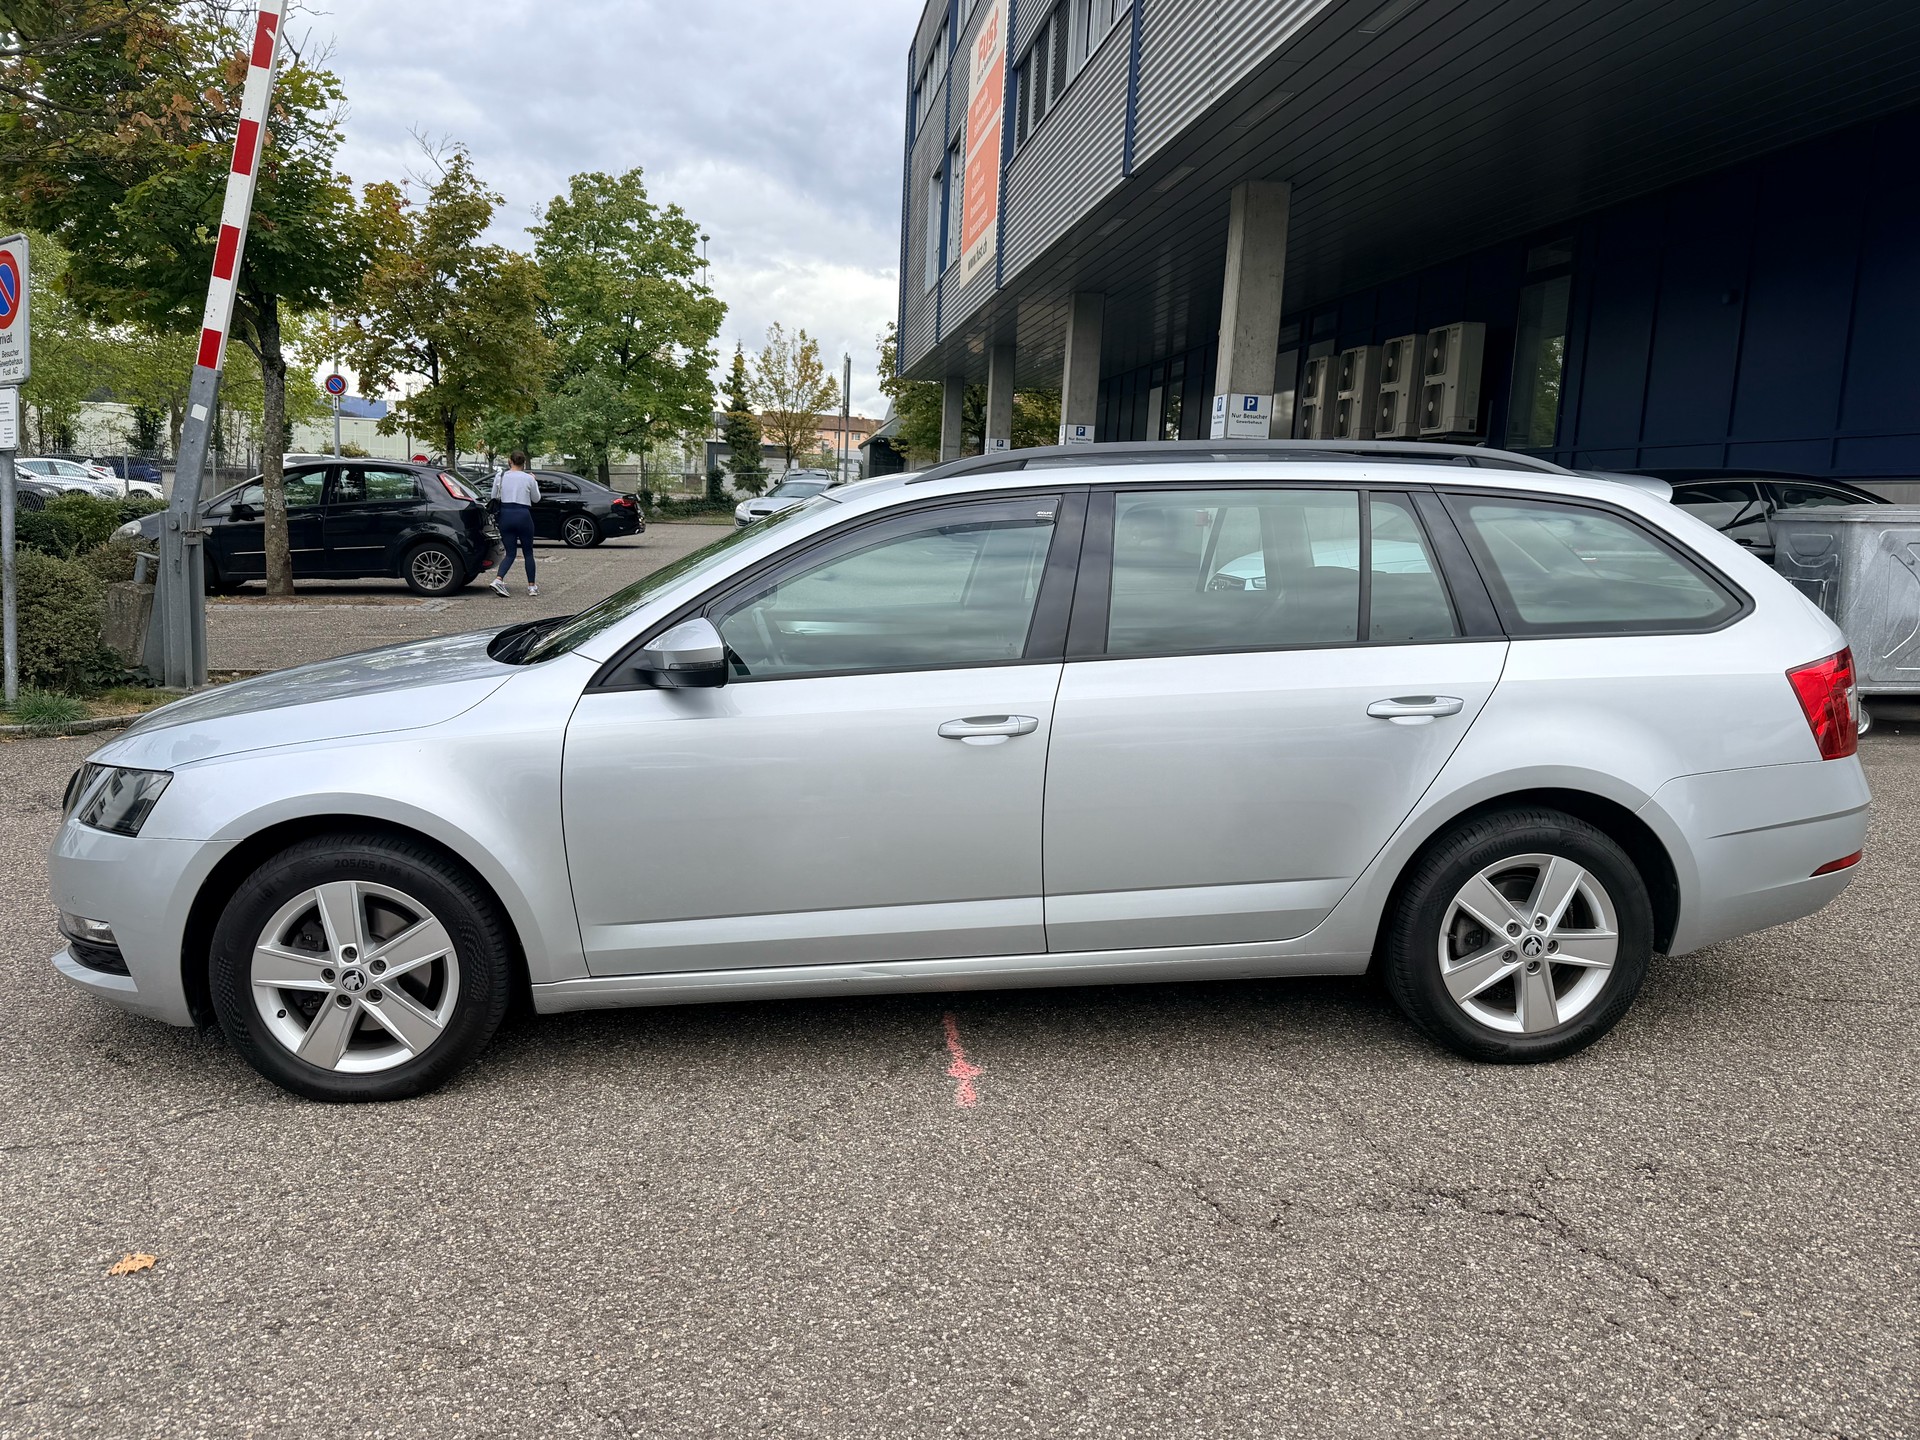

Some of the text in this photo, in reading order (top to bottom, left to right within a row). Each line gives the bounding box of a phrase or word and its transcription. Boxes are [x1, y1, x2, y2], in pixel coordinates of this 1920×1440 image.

[0, 331, 13, 345] rivat
[2, 349, 19, 359] Besucher
[2, 366, 19, 377] Fust AG
[1247, 398, 1255, 410] P
[333, 858, 376, 871] 205/55
[379, 863, 388, 873] R
[389, 866, 402, 877] 16
